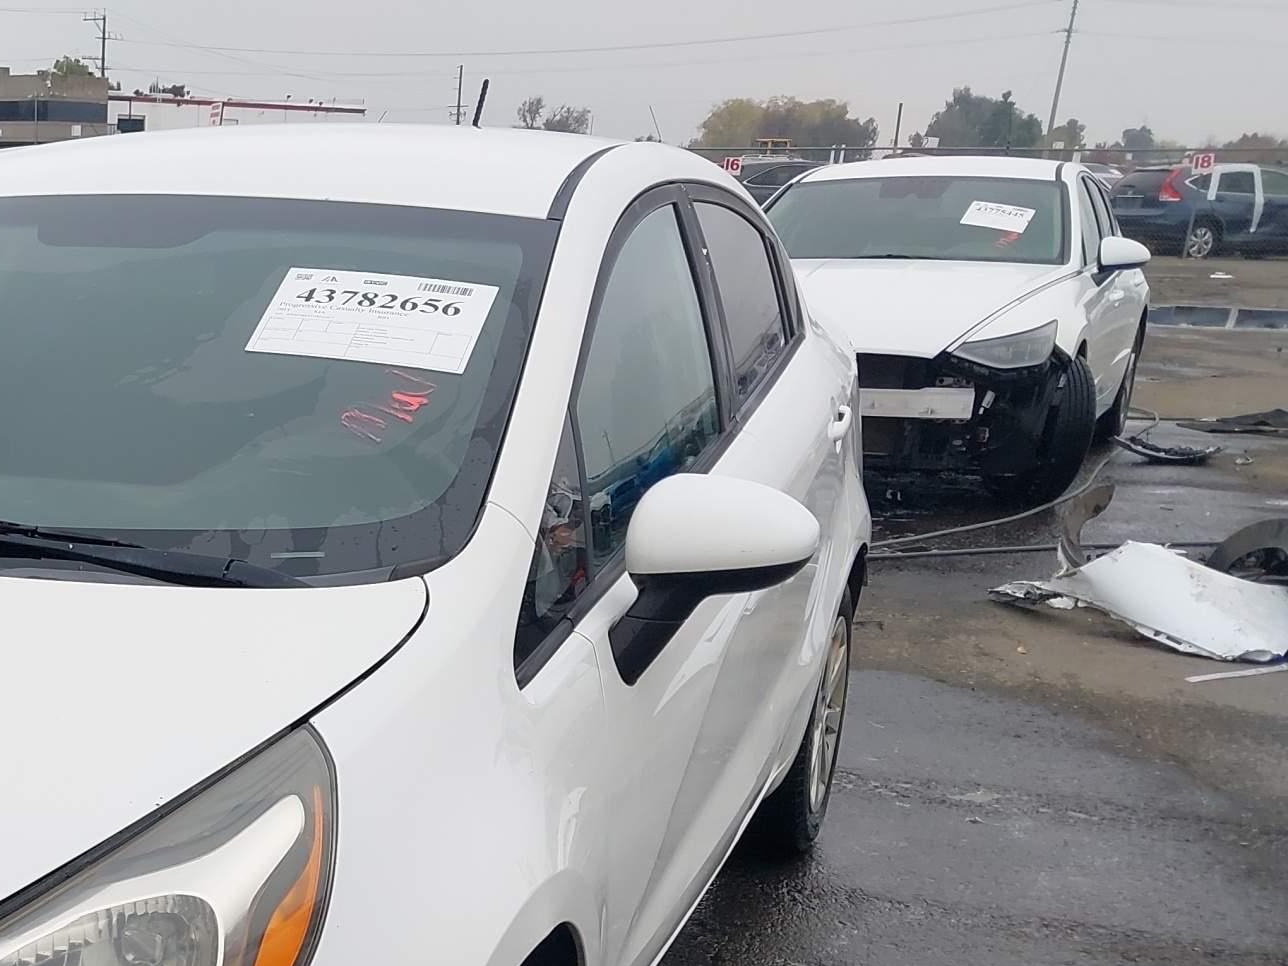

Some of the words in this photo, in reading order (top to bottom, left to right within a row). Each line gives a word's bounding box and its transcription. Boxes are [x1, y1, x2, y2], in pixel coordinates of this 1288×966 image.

[725, 158, 741, 171] 16
[1194, 154, 1212, 170] 18
[295, 287, 464, 317] 43782656
